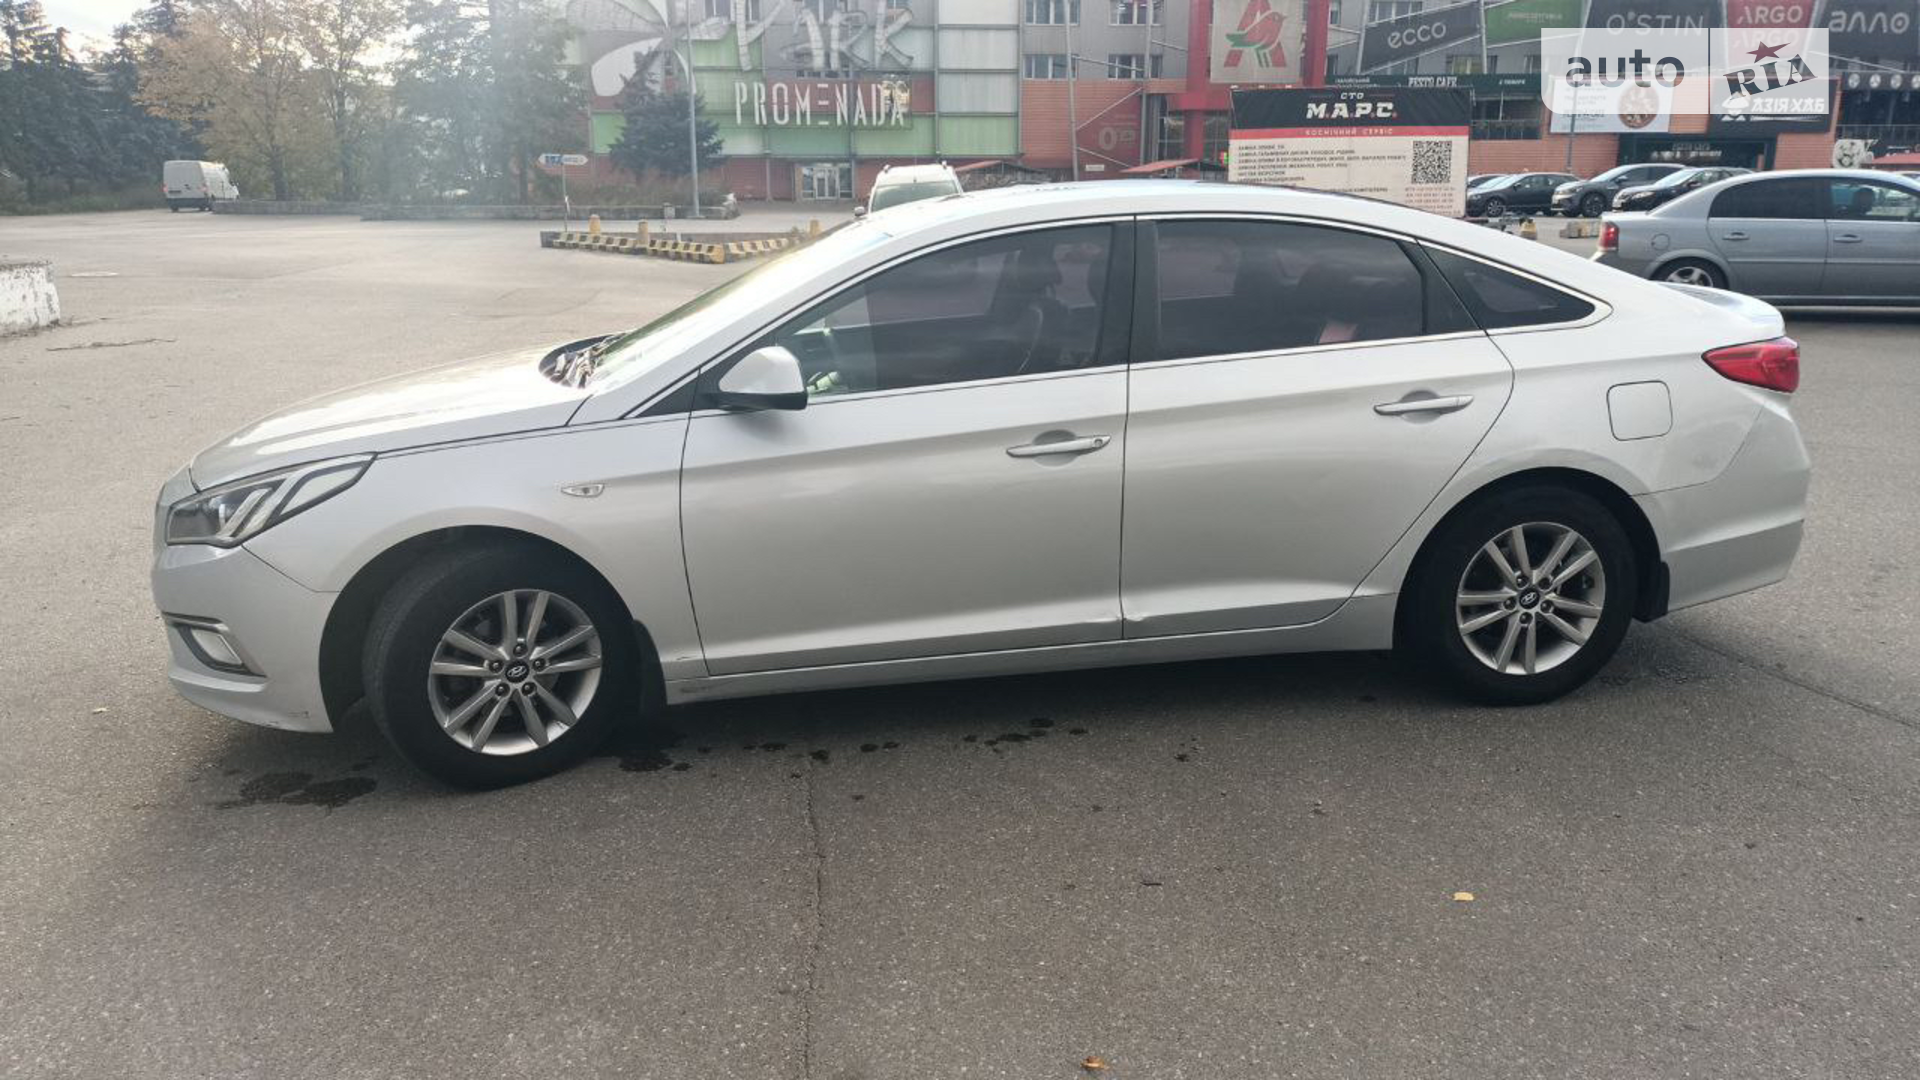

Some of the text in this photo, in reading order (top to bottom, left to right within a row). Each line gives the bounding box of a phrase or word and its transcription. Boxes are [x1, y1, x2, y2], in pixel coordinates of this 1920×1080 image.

[1737, 5, 1803, 24] ARGO
[1387, 22, 1447, 48] ecco
[734, 82, 905, 125] PROMENADA
[1340, 92, 1365, 100] СТО
